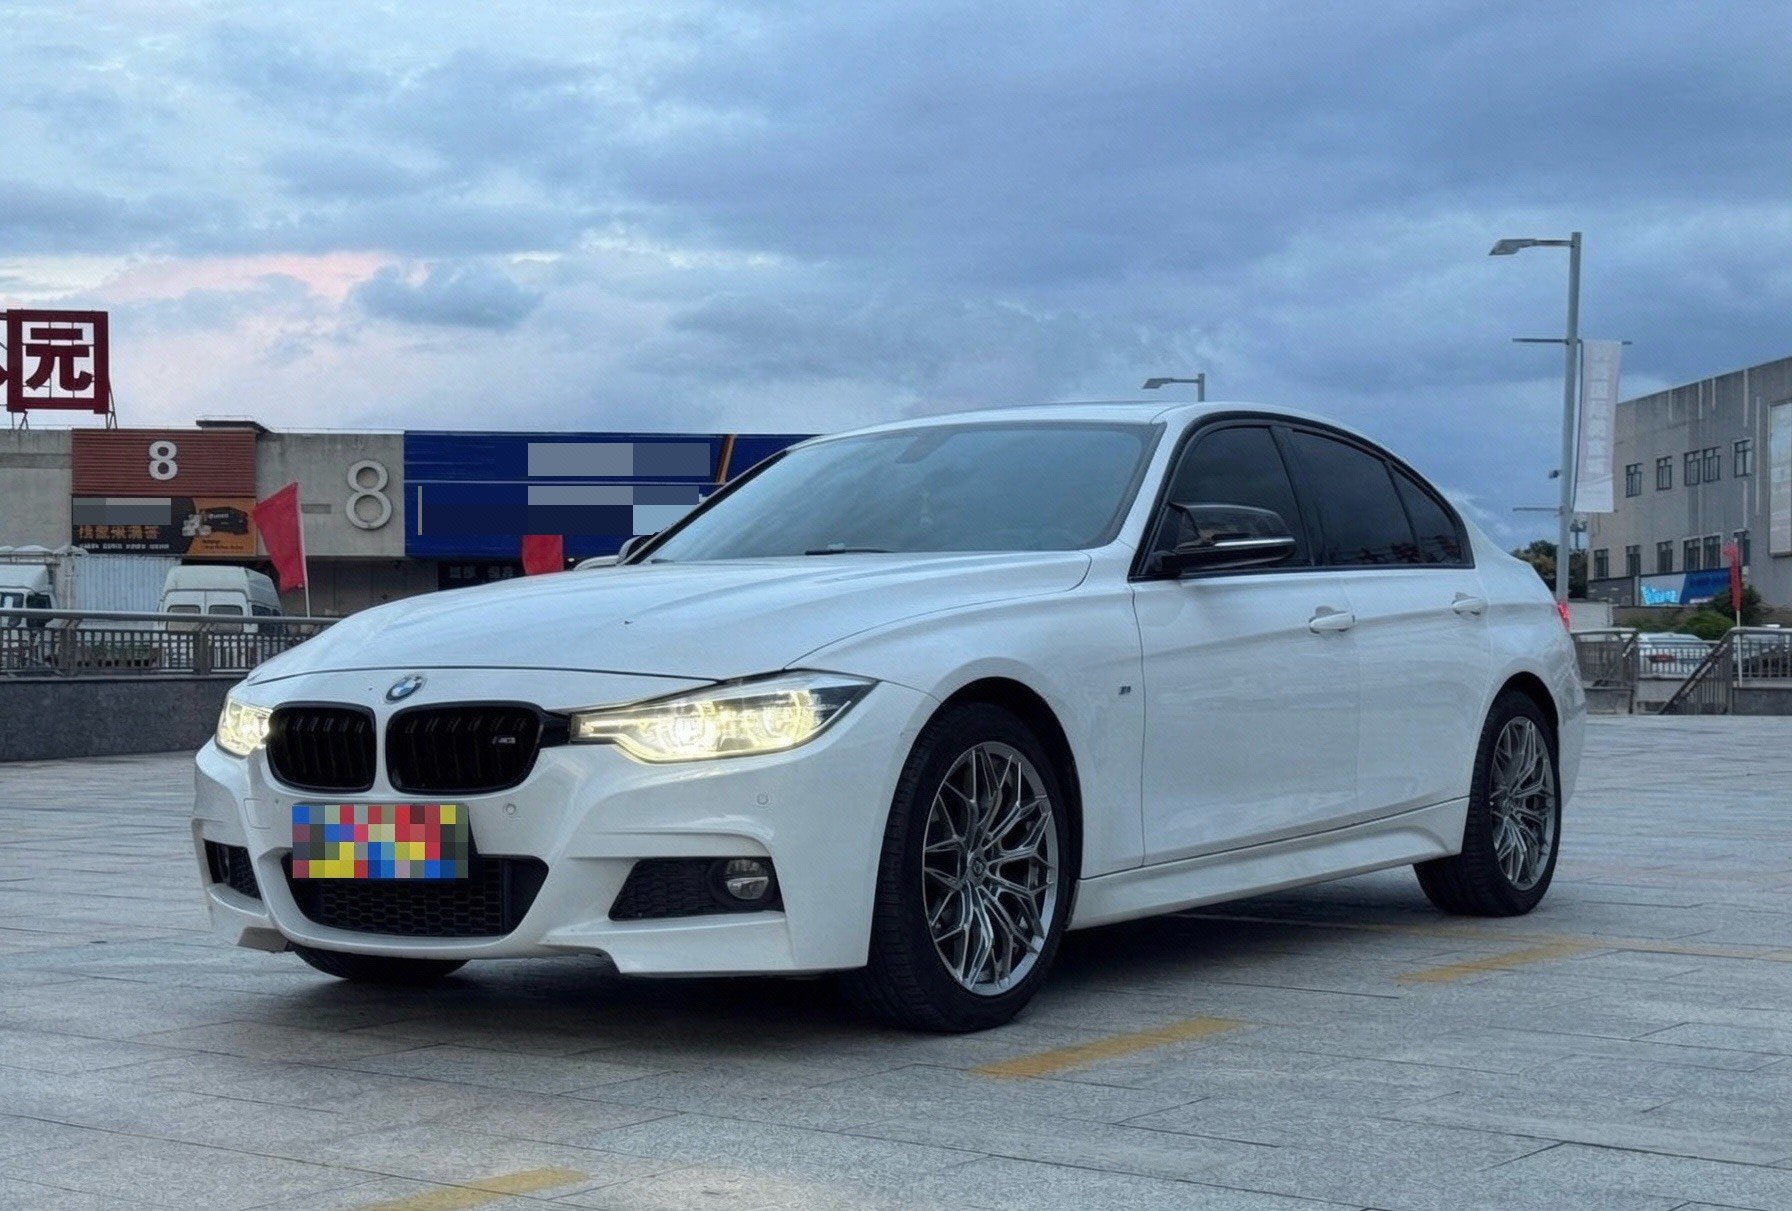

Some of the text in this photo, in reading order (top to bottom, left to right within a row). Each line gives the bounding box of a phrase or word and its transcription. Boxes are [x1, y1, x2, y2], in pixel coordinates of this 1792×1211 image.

[0, 309, 109, 414] 园
[148, 440, 178, 480] 8
[346, 459, 392, 529] 8
